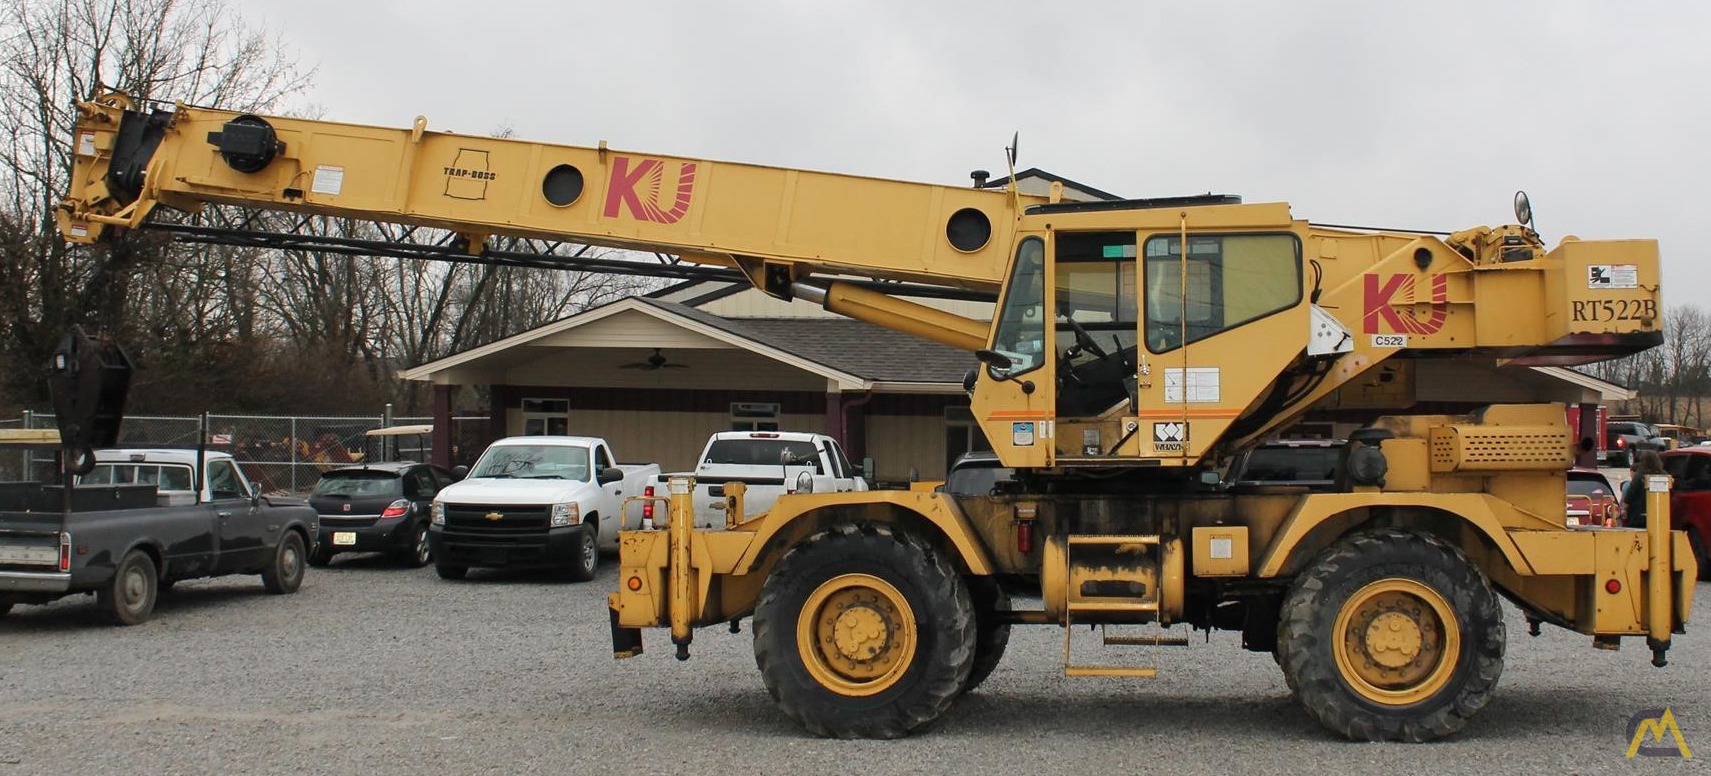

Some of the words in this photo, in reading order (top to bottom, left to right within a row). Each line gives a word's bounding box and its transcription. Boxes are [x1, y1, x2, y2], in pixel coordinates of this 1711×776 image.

[444, 167, 496, 180] TRAP-BOSS
[603, 156, 697, 224] KU
[1571, 299, 1657, 322] RT522B
[1375, 336, 1403, 346] C522
